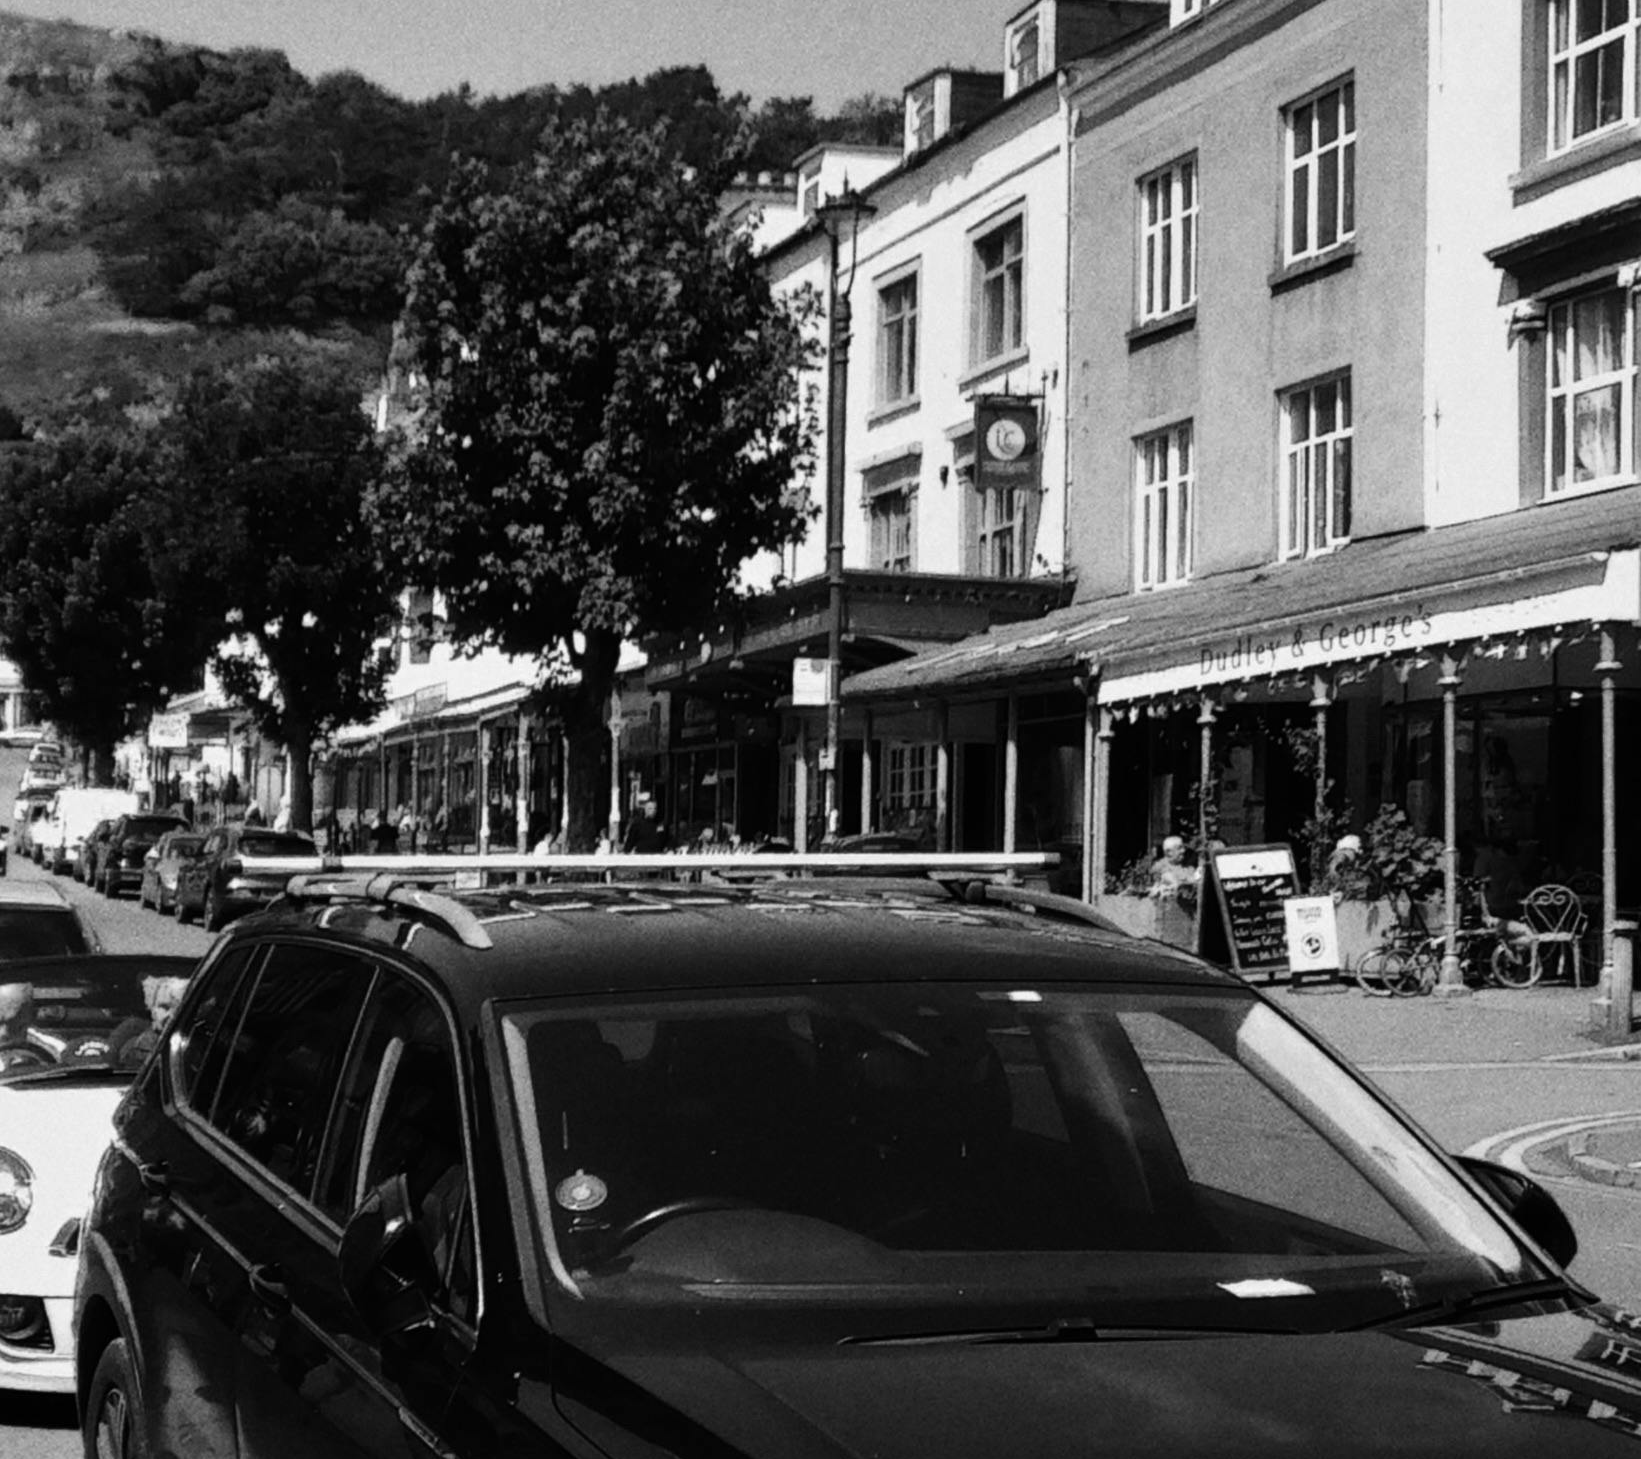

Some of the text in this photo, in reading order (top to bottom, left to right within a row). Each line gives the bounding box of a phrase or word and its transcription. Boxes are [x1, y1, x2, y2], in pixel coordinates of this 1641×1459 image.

[1200, 604, 1433, 675] Dudley & George's
